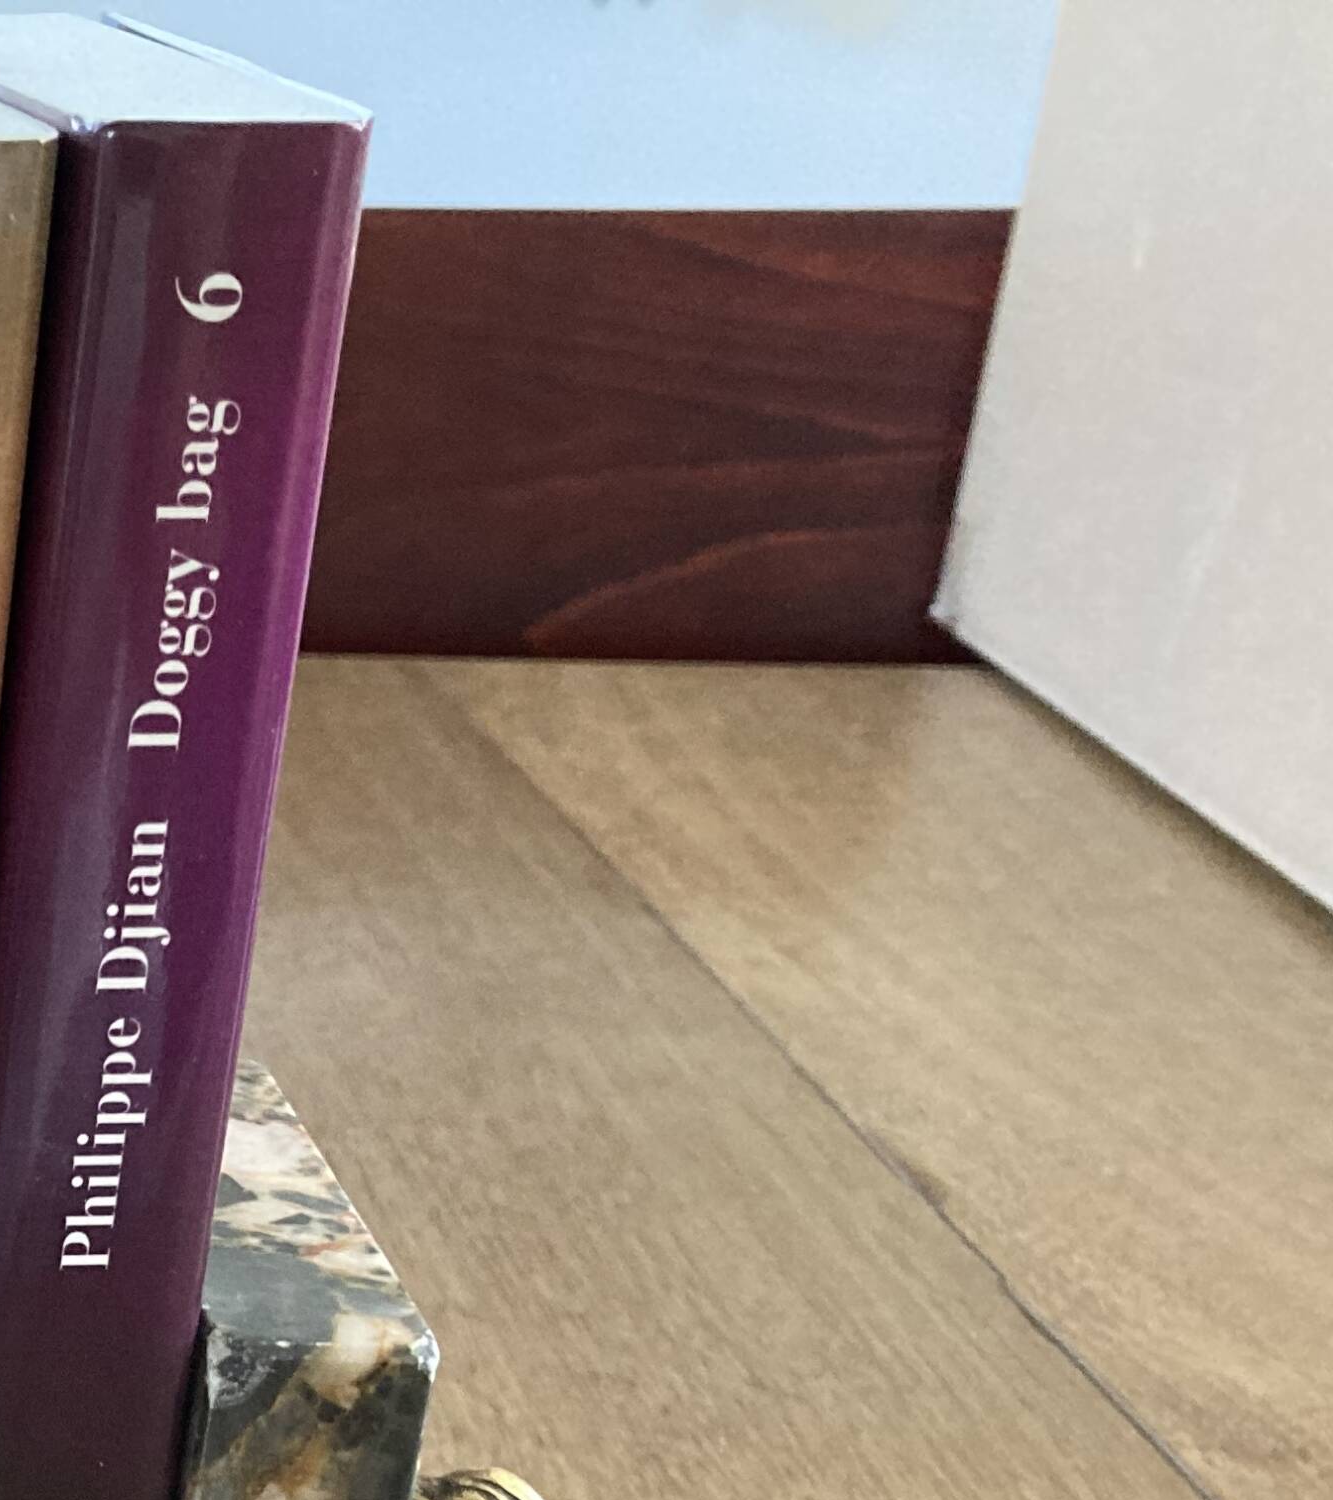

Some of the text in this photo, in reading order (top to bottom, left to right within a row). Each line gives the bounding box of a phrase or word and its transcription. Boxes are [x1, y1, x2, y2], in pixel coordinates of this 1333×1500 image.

[60, 272, 243, 1268] Philippe Djian Doggy bag 6
